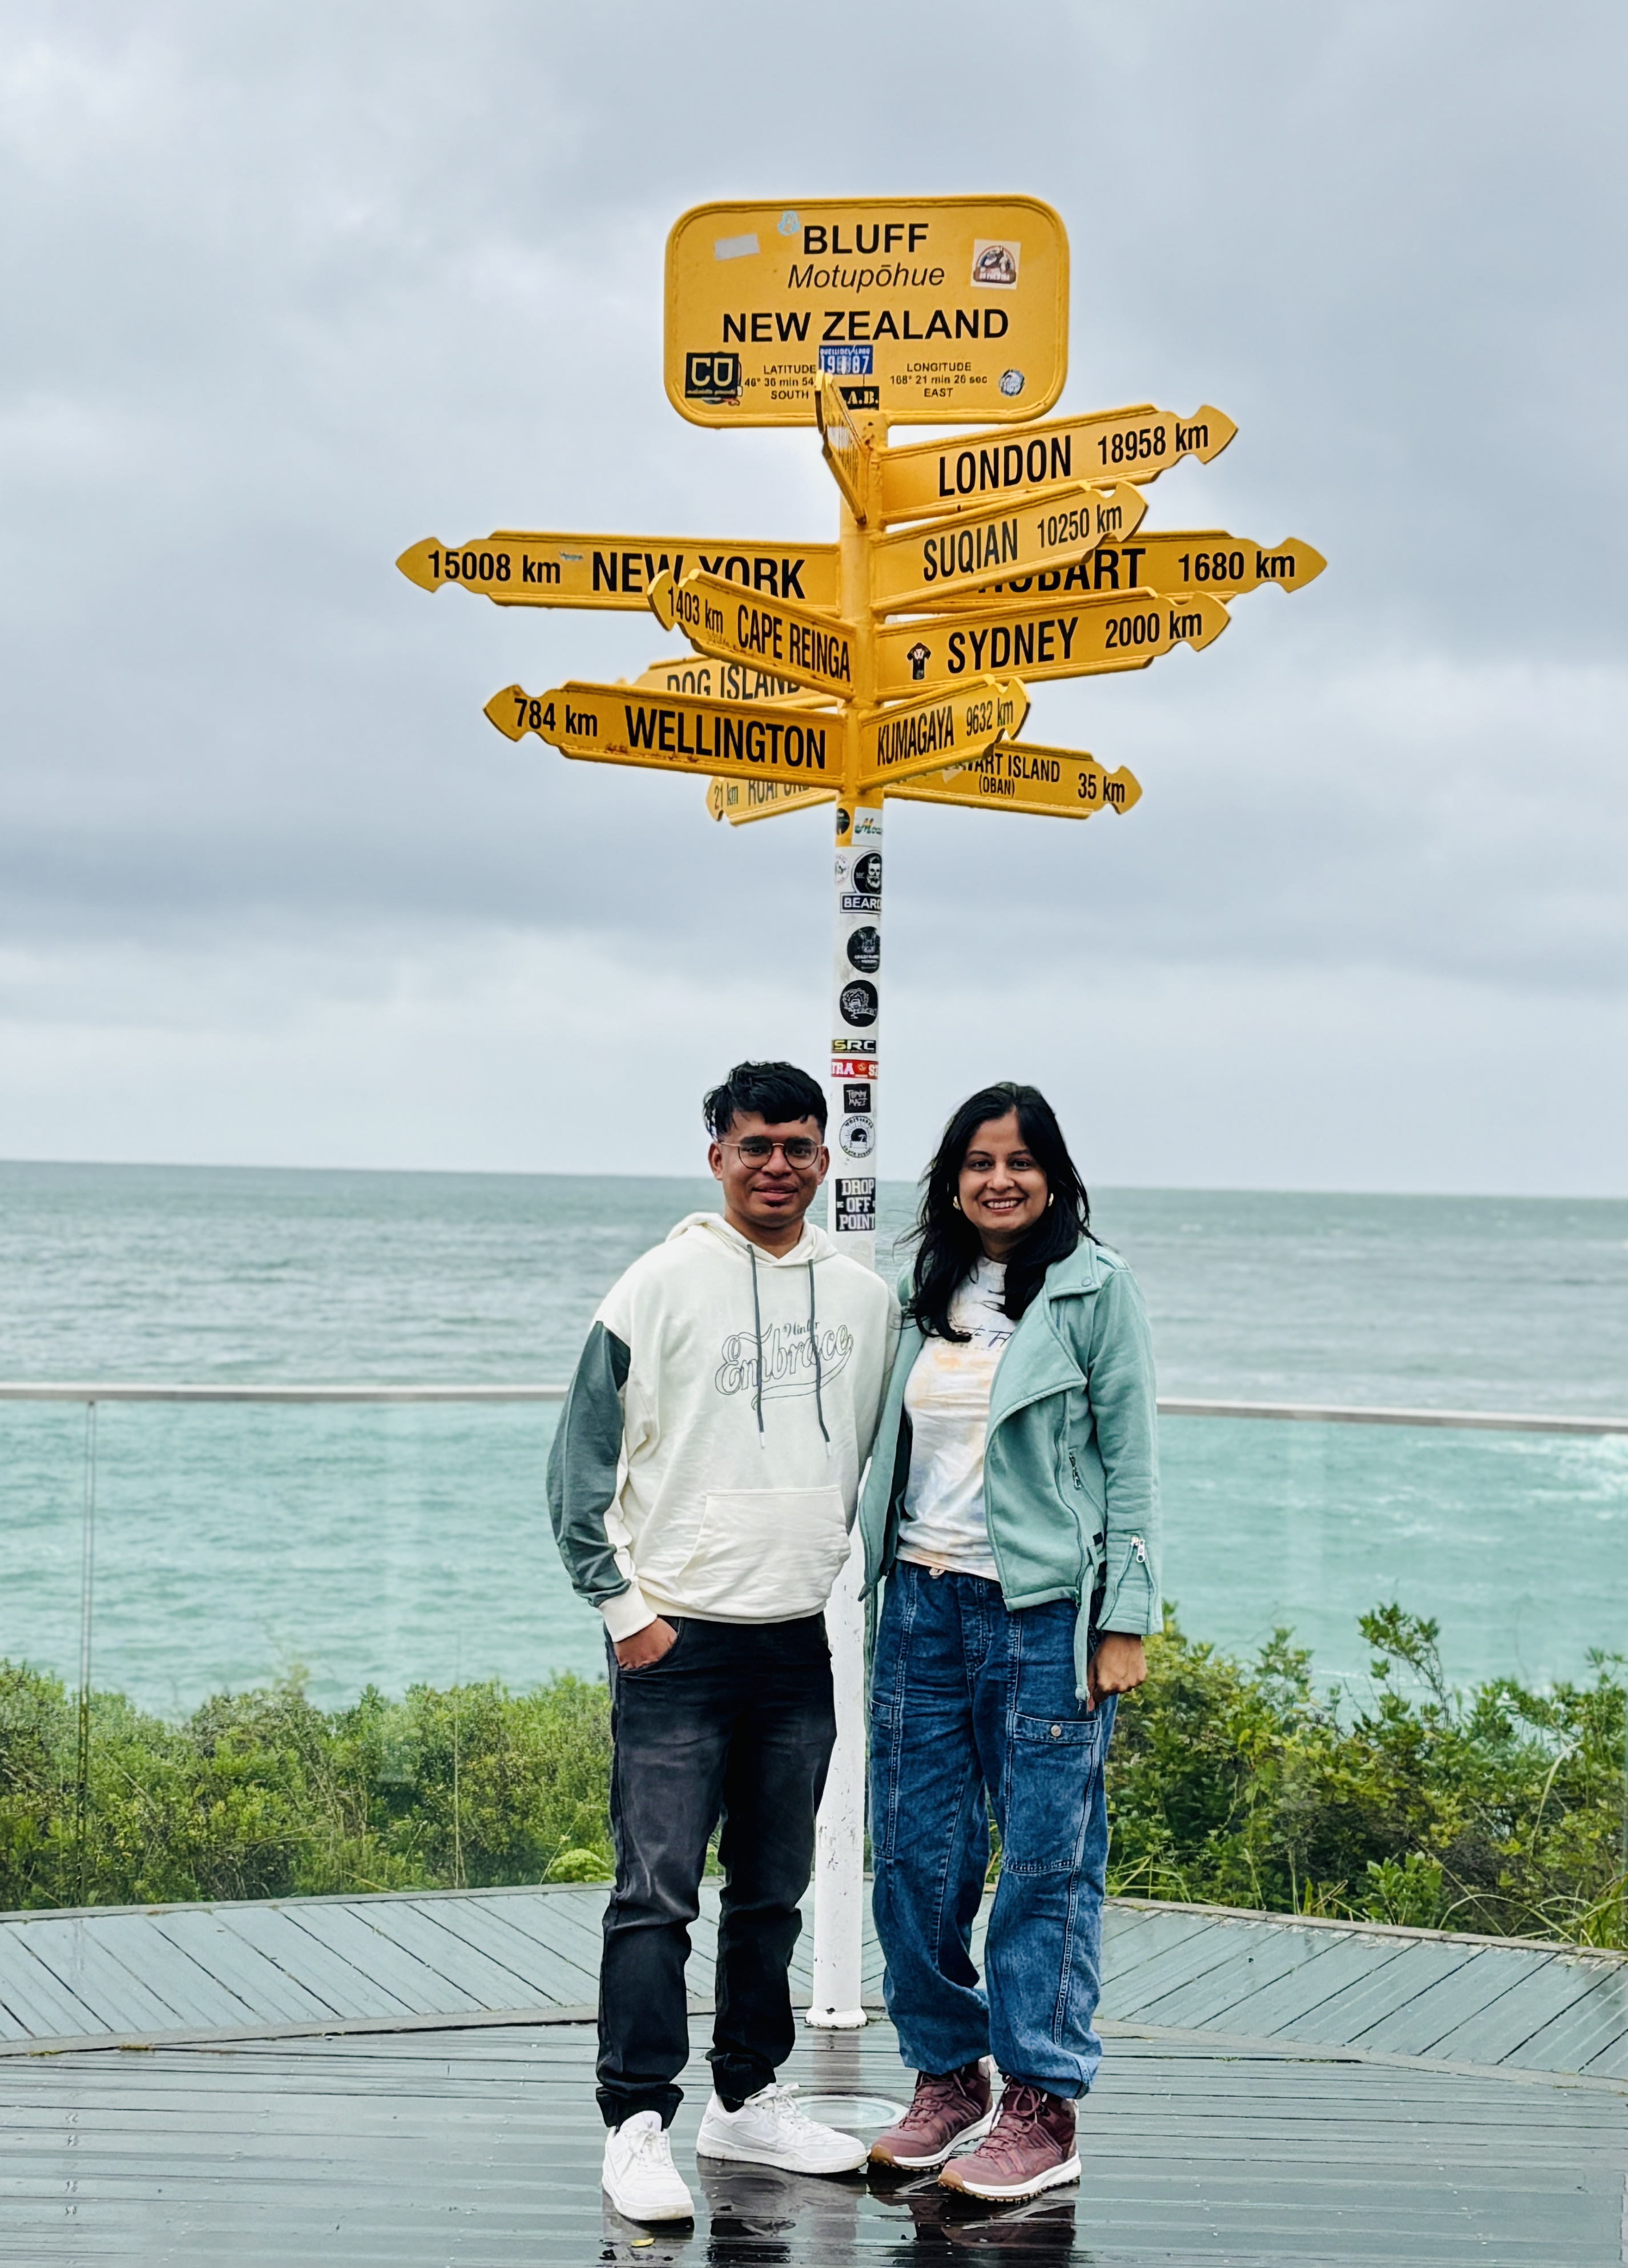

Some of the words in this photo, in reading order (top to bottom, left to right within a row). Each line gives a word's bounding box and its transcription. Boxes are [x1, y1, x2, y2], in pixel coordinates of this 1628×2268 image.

[803, 223, 929, 255] BLUFF
[787, 262, 945, 293] Motupōhue
[723, 312, 811, 343] NEW
[822, 309, 1009, 341] ZEALAND
[763, 364, 817, 374] LATITUDE
[907, 362, 972, 372] LONGITUDE
[916, 374, 927, 384] 21
[931, 374, 950, 384] min
[764, 377, 776, 387] 36
[779, 377, 799, 386] min
[771, 390, 808, 400] SOUTH
[924, 387, 953, 398] EAST
[939, 434, 1071, 497] LONDON
[1097, 420, 1166, 465] 18958
[1175, 422, 1208, 453] km
[923, 518, 1018, 582] SUQIAN
[1037, 509, 1090, 548] 10250
[1096, 503, 1123, 534] km
[428, 550, 511, 581] 15008
[522, 555, 561, 584] km
[1178, 551, 1244, 583] 1680
[1256, 550, 1296, 579] km
[668, 586, 700, 626] 1403
[705, 599, 723, 634] km
[738, 604, 783, 659] CAPE
[789, 622, 851, 682] REINGA
[948, 617, 1079, 674] SYDNEY
[1105, 613, 1160, 648] 2000
[1169, 610, 1203, 639] km
[514, 697, 556, 731] 784
[565, 704, 598, 737] km
[624, 705, 826, 770] WELLINGTON
[877, 705, 954, 767] KUMAGAYA
[966, 700, 993, 736] 9632
[997, 698, 1013, 727] km
[1008, 755, 1060, 783] ISLAND
[714, 784, 723, 810] 21
[727, 782, 738, 807] km
[979, 774, 1015, 798] (OBAN)
[1077, 774, 1098, 800] 35
[1102, 775, 1126, 803] km
[834, 1040, 875, 1050] SRC
[841, 1179, 875, 1196] DROP
[846, 1197, 871, 1212] OFF
[839, 1213, 875, 1230] POINT
[715, 1323, 854, 1395] Embrace
